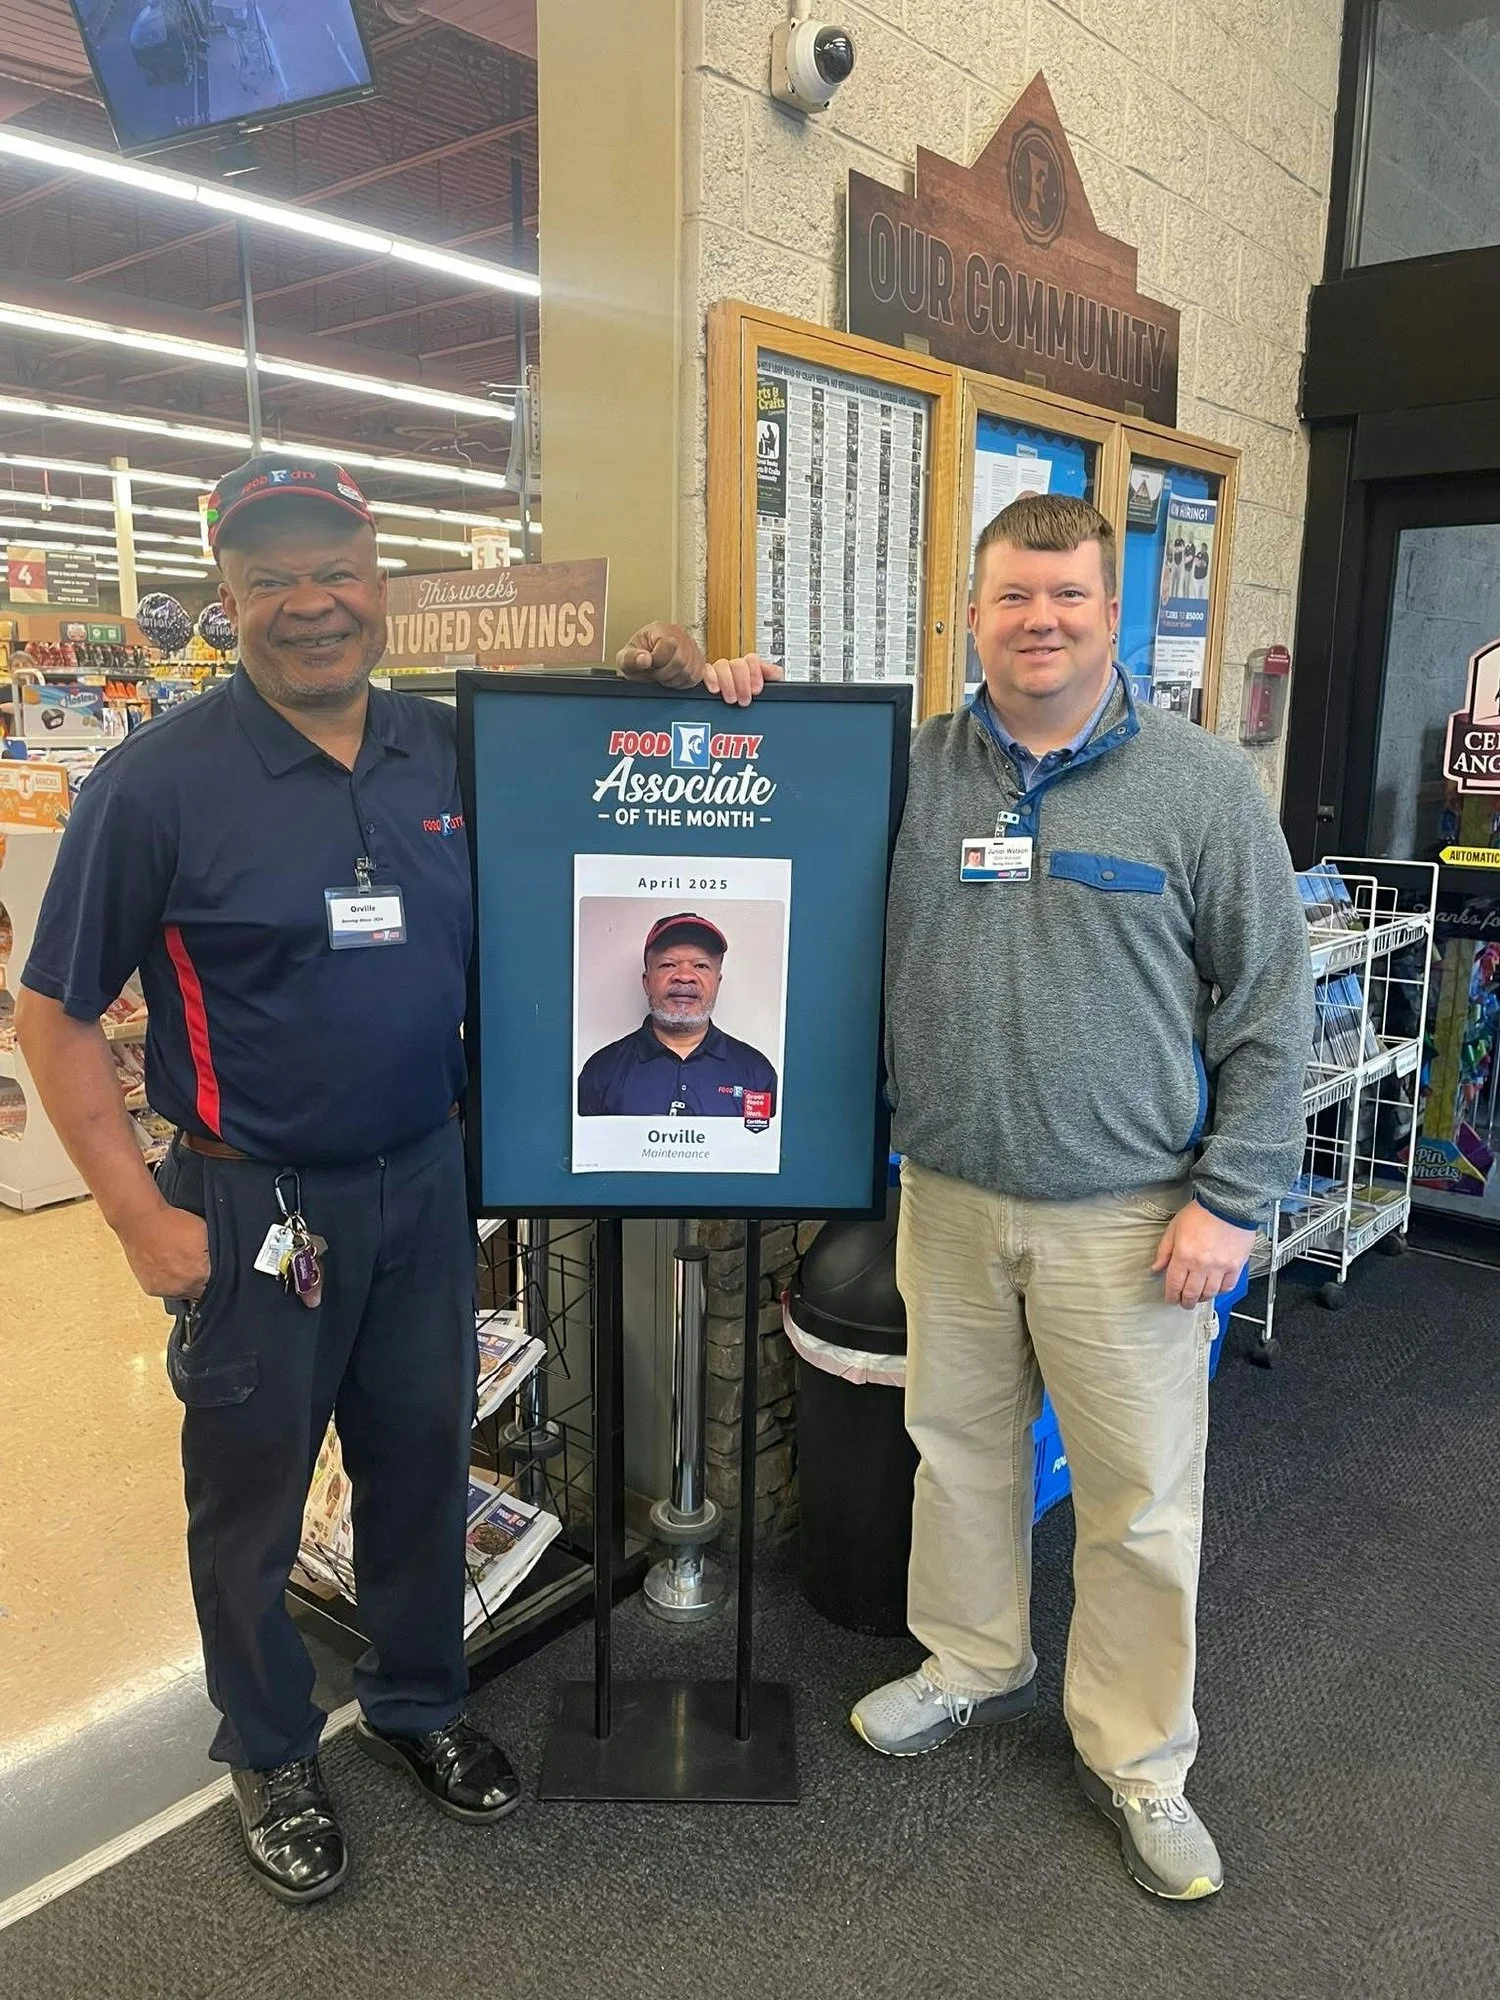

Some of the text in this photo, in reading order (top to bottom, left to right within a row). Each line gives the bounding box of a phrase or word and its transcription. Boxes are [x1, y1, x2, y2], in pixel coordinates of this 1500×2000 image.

[869, 212, 1168, 393] OUR COMMUNITY
[18, 564, 33, 587] 4
[418, 571, 518, 609] This week's
[476, 600, 595, 651] SAVINGS
[609, 731, 671, 756] FOOD
[710, 733, 763, 759] CITY
[1452, 752, 1500, 774] ANG
[592, 757, 777, 805] Associate
[422, 818, 441, 832] FOOD
[615, 808, 754, 827] OF THE MONTH
[1449, 850, 1500, 864] AUTOMATIC
[638, 877, 728, 891] April 2025
[350, 905, 376, 913] Orville
[1413, 903, 1481, 925] Tanks
[647, 1129, 706, 1143] Orville
[640, 1148, 711, 1159] Maintenance
